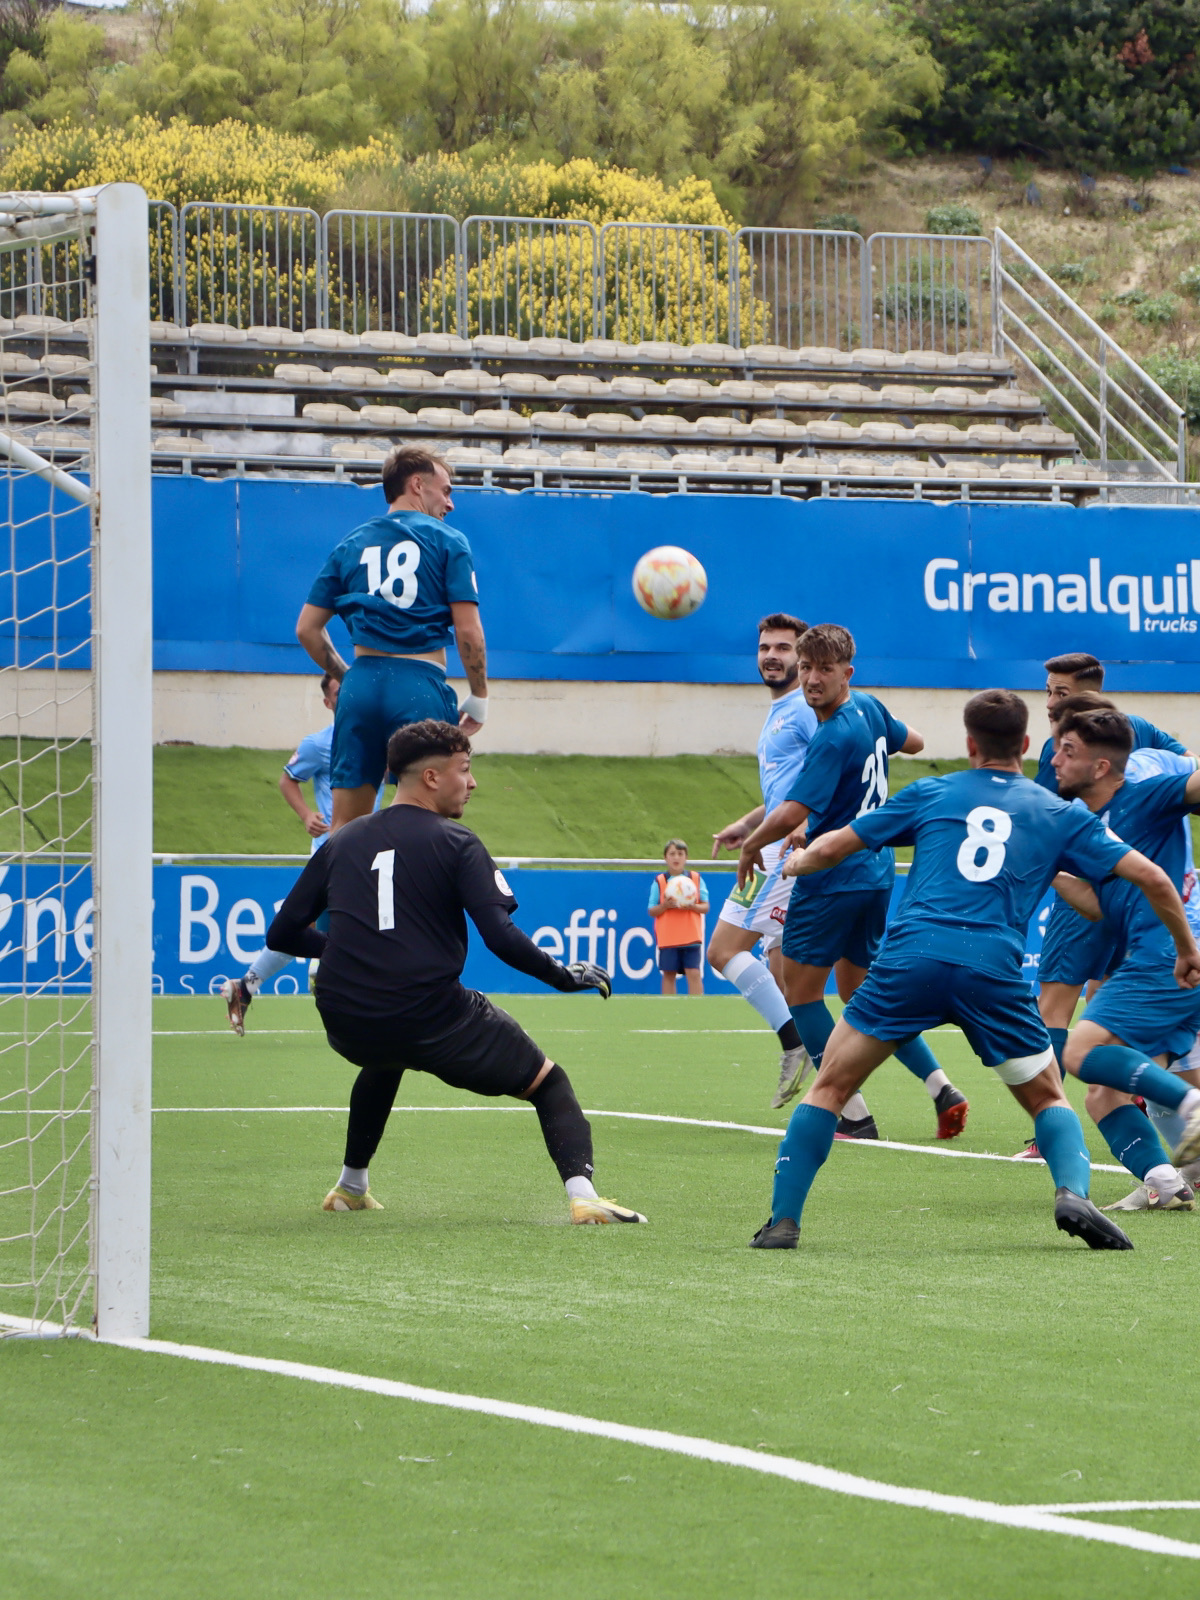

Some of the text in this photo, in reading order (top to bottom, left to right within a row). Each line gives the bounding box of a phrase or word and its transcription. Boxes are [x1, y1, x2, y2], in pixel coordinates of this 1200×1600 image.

[360, 540, 421, 609] 18
[1144, 617, 1197, 632] trucks
[957, 806, 1012, 882] 8
[371, 849, 395, 930] 1
